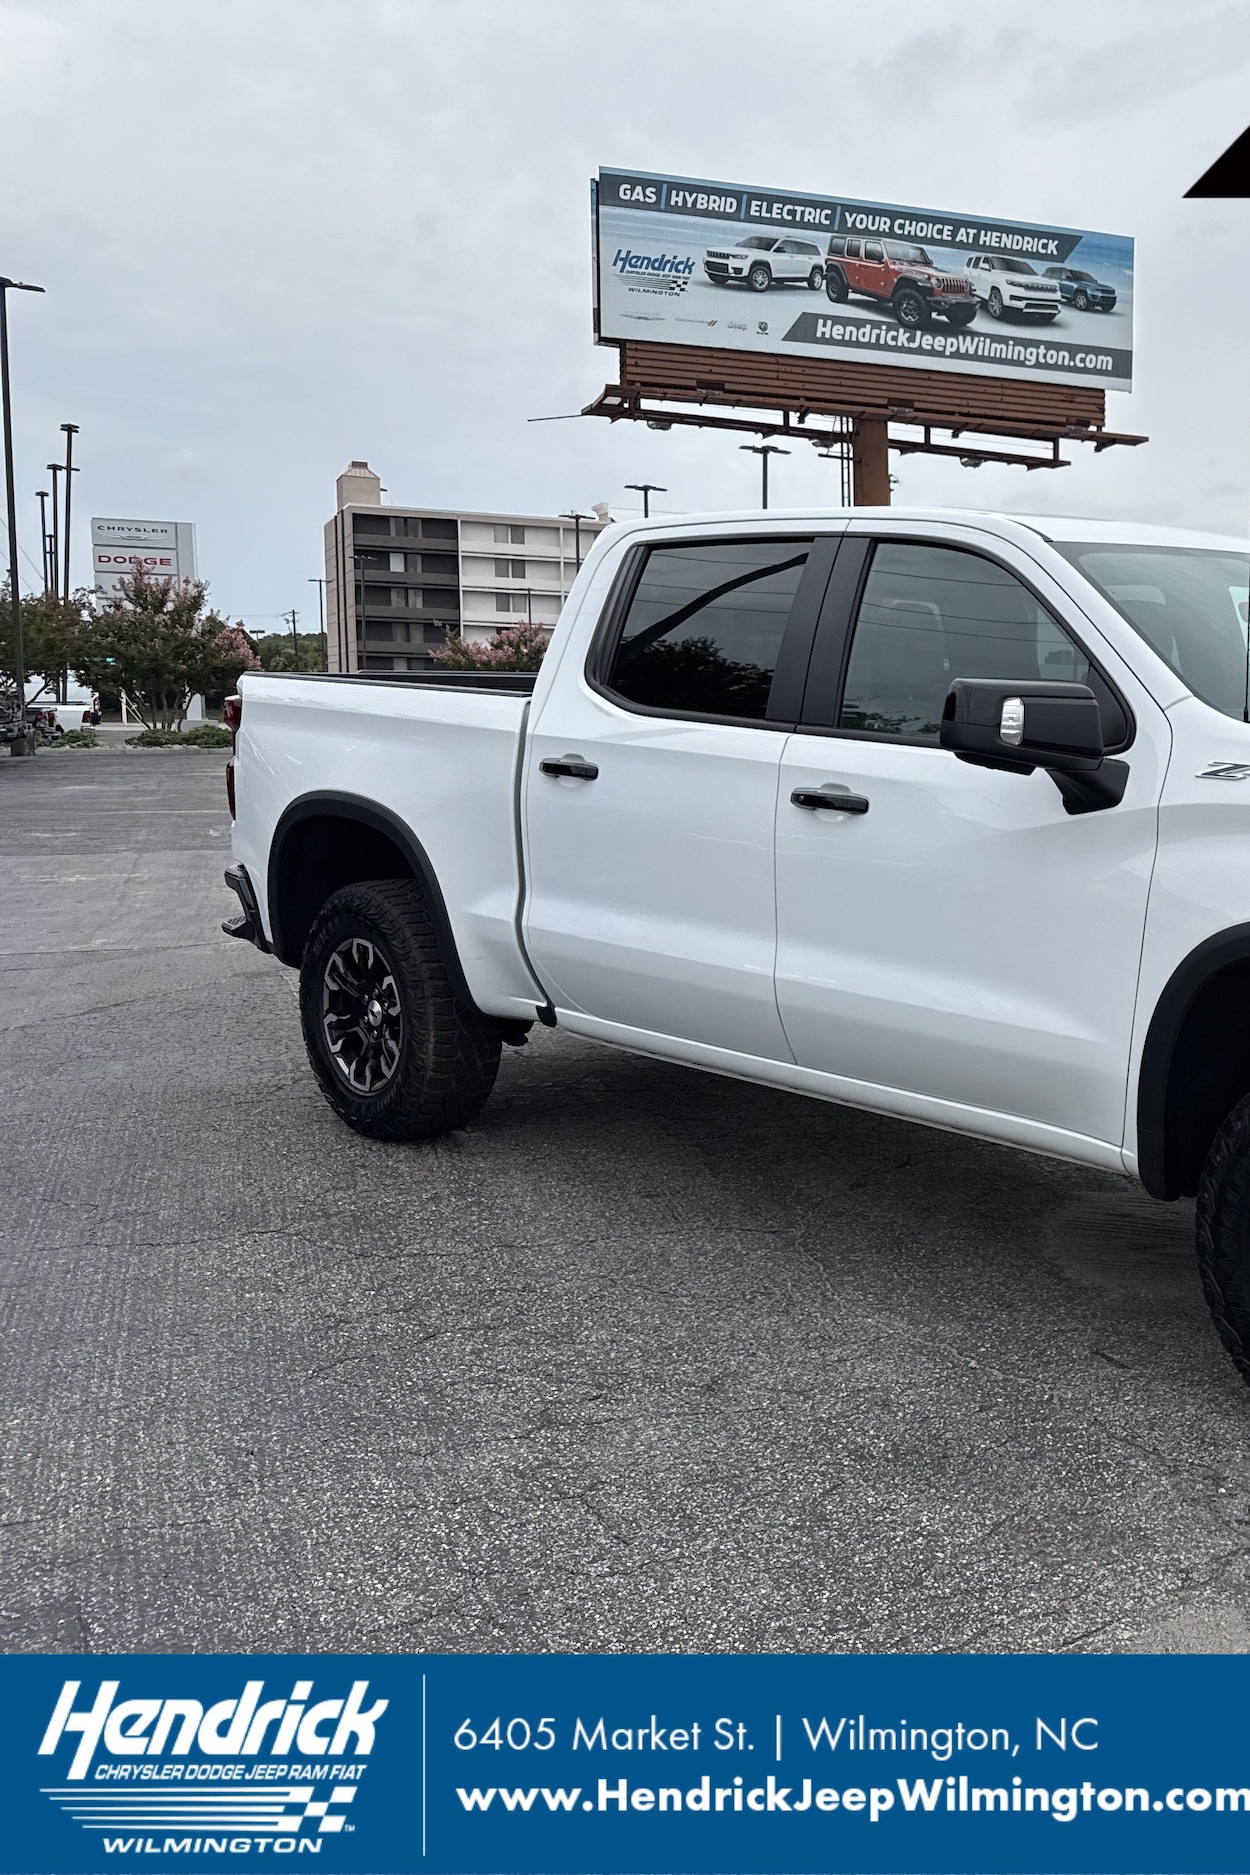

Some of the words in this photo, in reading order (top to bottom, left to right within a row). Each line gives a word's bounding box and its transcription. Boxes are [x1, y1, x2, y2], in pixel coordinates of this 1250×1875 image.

[618, 183, 657, 204] GAS
[670, 190, 738, 214] HYBRID
[750, 200, 832, 225] ELECTRIC
[844, 211, 891, 233] YOUR
[893, 218, 953, 241] CHOICE
[955, 227, 977, 243] AT
[979, 230, 1060, 255] HENDRICK
[612, 249, 696, 275] Hendrick
[628, 287, 681, 297] WILMINGTON
[816, 318, 1113, 371] HendrickJeepWilmington.com
[97, 525, 168, 534] CHRYSLER
[98, 555, 172, 566] DODGE
